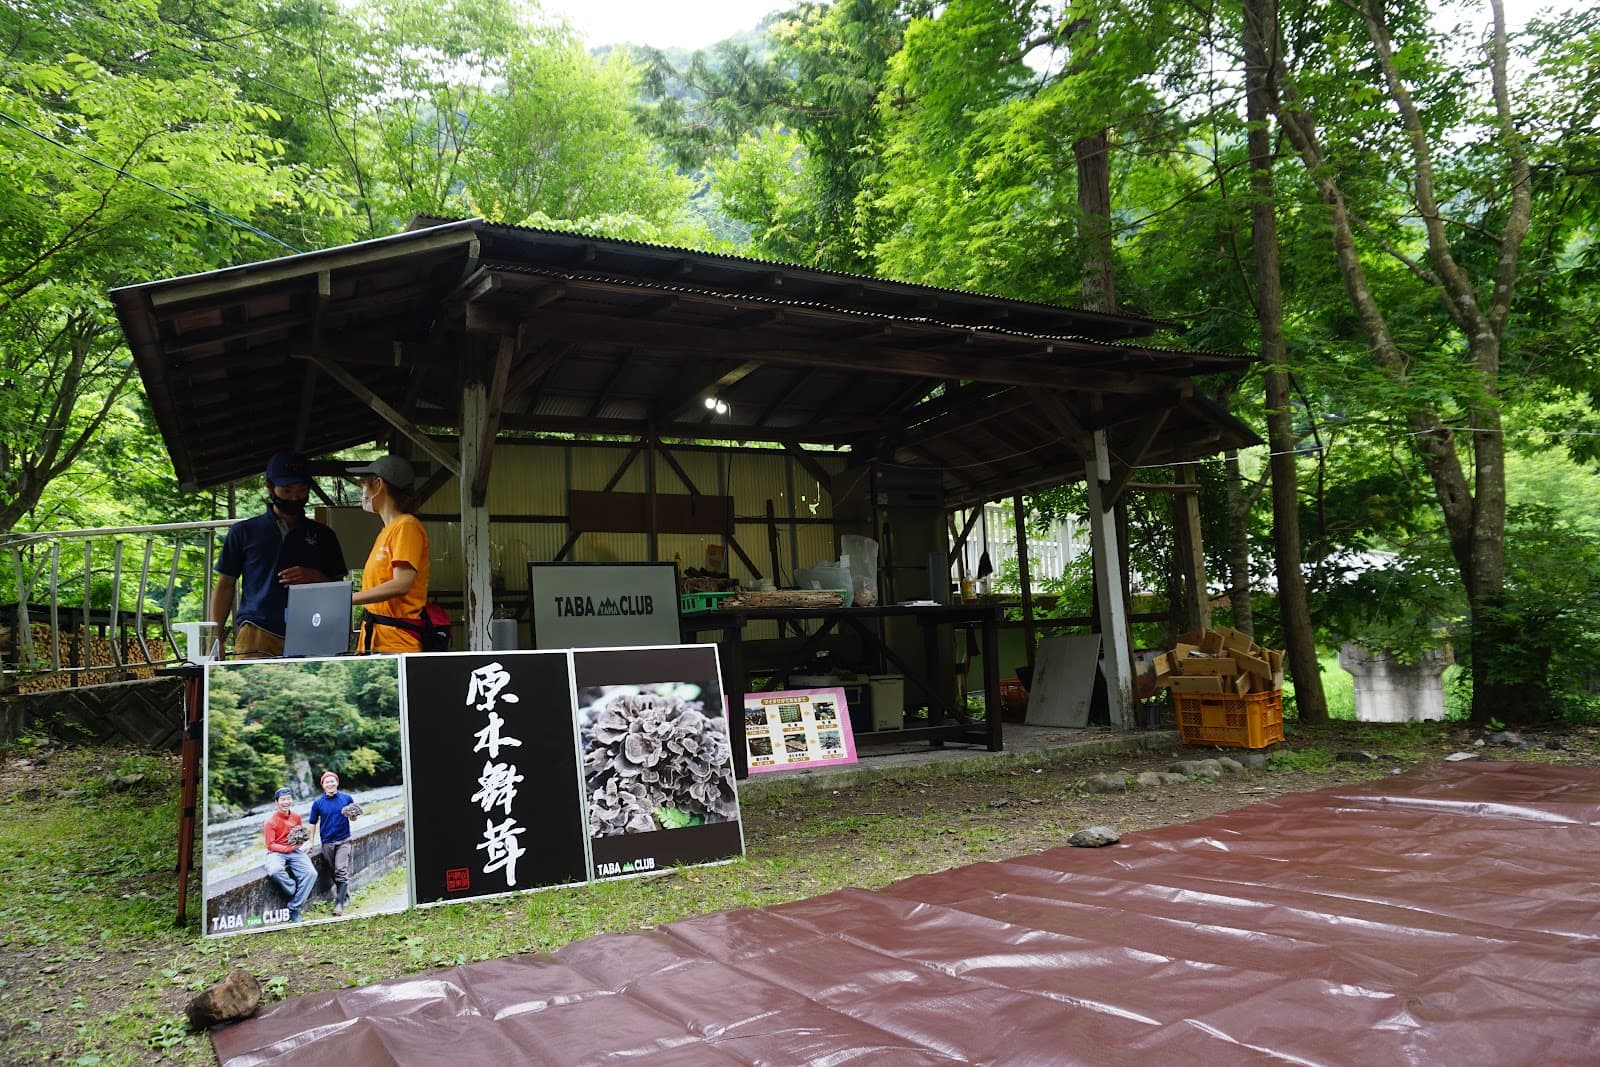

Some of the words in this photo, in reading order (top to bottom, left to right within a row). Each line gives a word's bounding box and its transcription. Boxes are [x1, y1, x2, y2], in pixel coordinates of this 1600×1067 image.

[555, 596, 595, 617] TABA
[619, 595, 654, 615] CLUB
[466, 661, 527, 888] 原木舞茸
[597, 862, 621, 875] TABA
[634, 858, 655, 870] CLUB
[211, 914, 244, 931] TABA
[262, 908, 290, 924] CLUB
